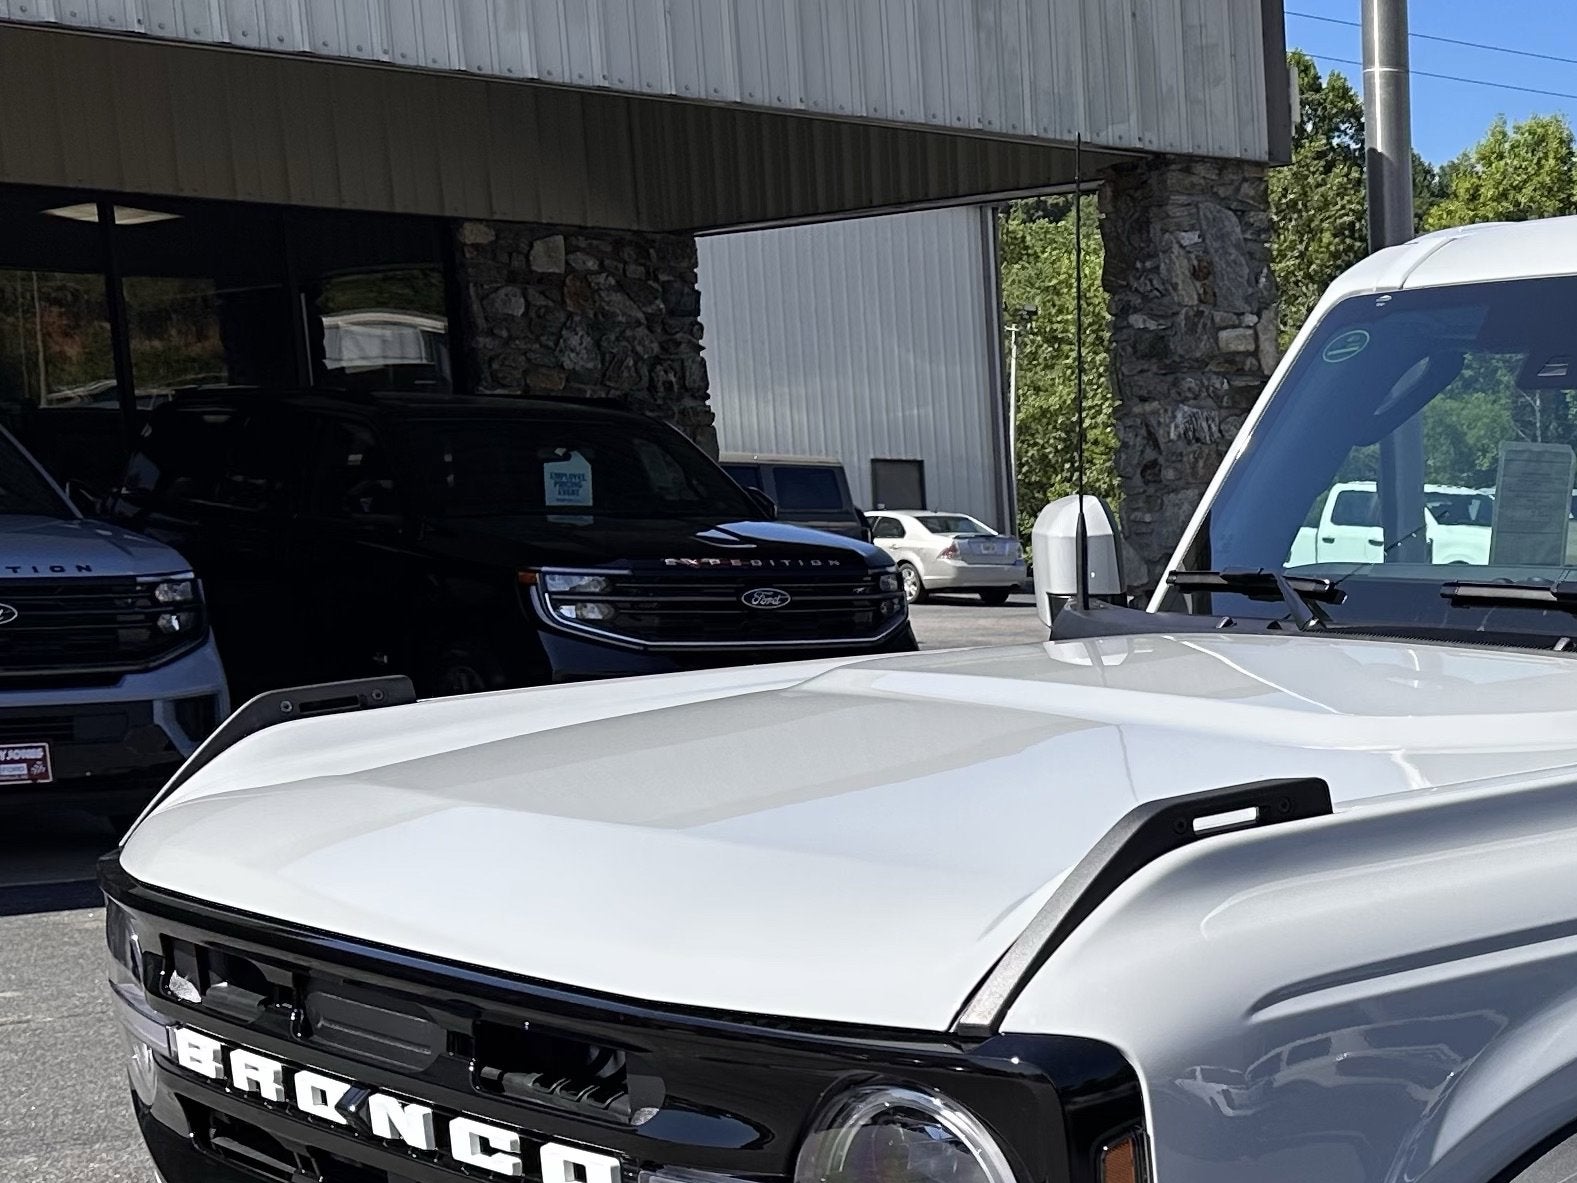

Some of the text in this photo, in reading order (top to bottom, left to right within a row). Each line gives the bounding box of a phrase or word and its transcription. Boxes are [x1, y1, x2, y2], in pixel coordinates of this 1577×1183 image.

[664, 558, 841, 567] EXPEDITION
[4, 564, 93, 574] TION
[748, 590, 786, 606] Ford
